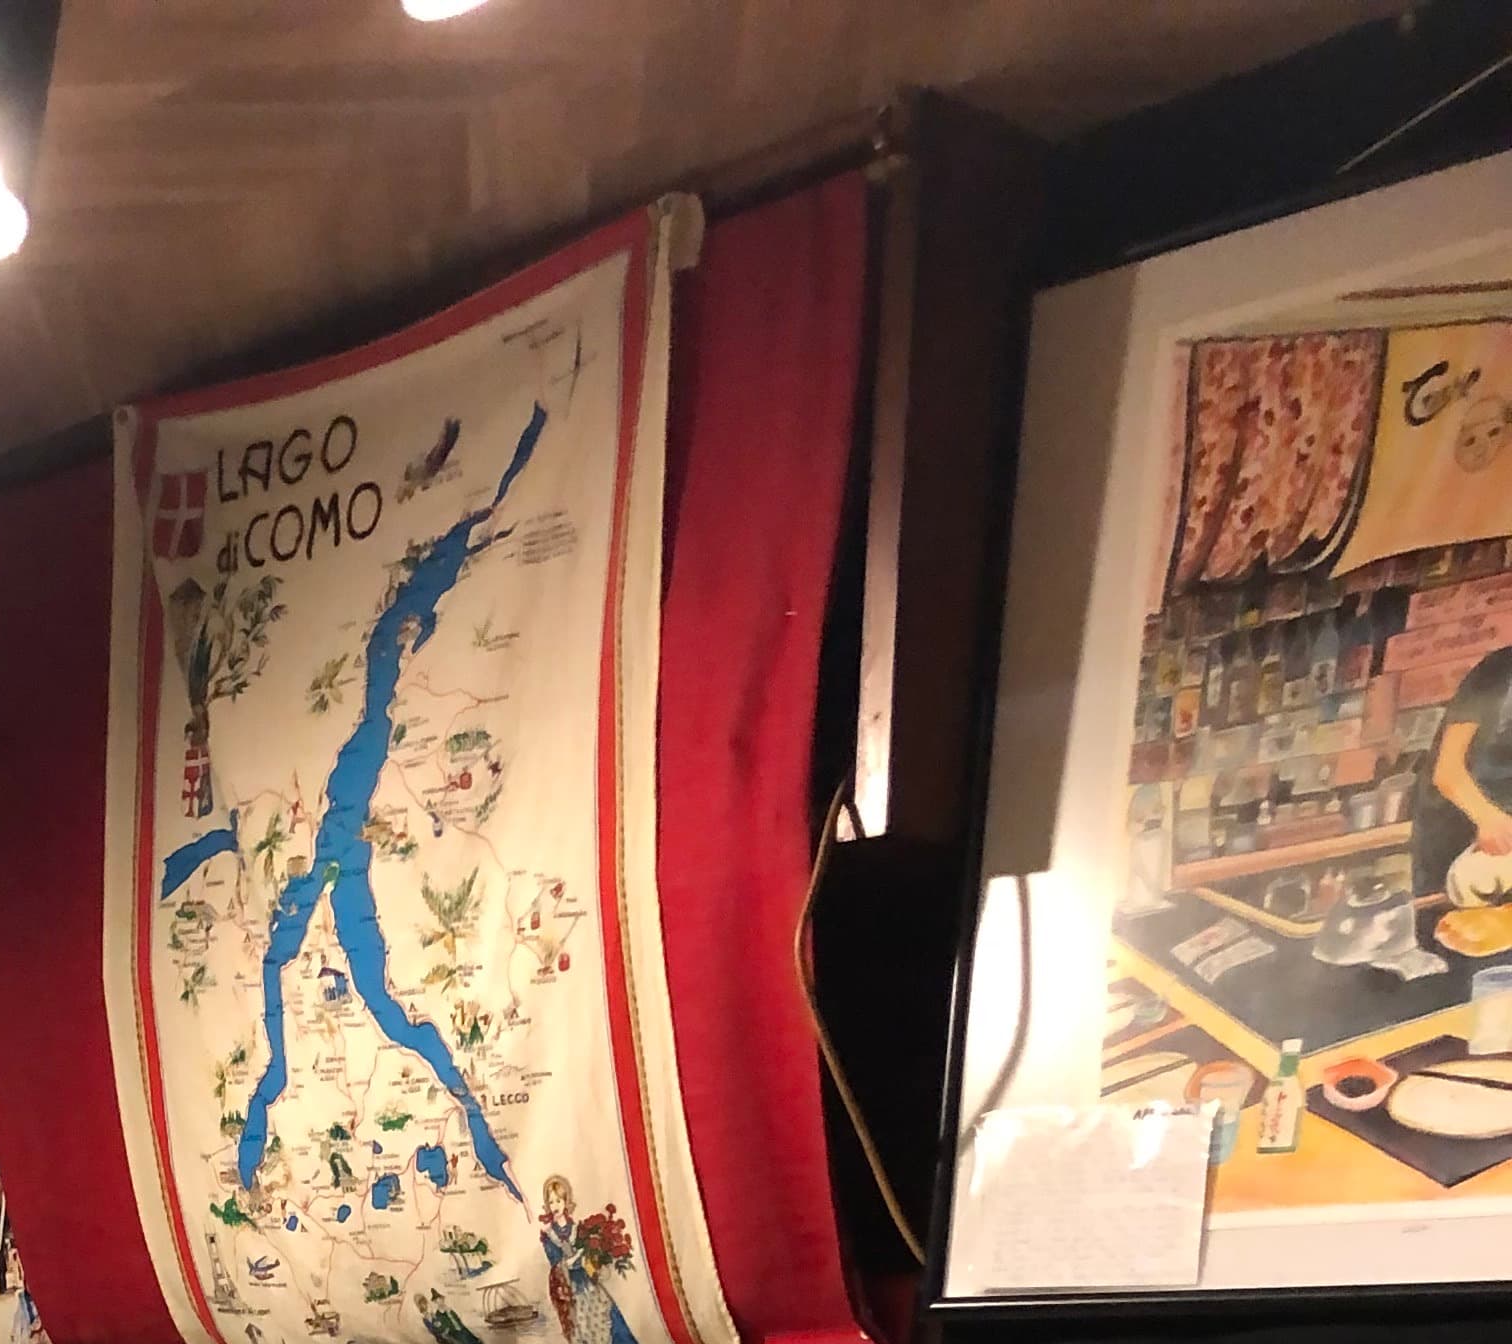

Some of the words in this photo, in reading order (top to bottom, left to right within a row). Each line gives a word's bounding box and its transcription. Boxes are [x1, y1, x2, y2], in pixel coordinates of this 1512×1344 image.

[217, 415, 358, 504] LAGO
[244, 482, 383, 568] COMO
[492, 1093, 530, 1107] LECCO
